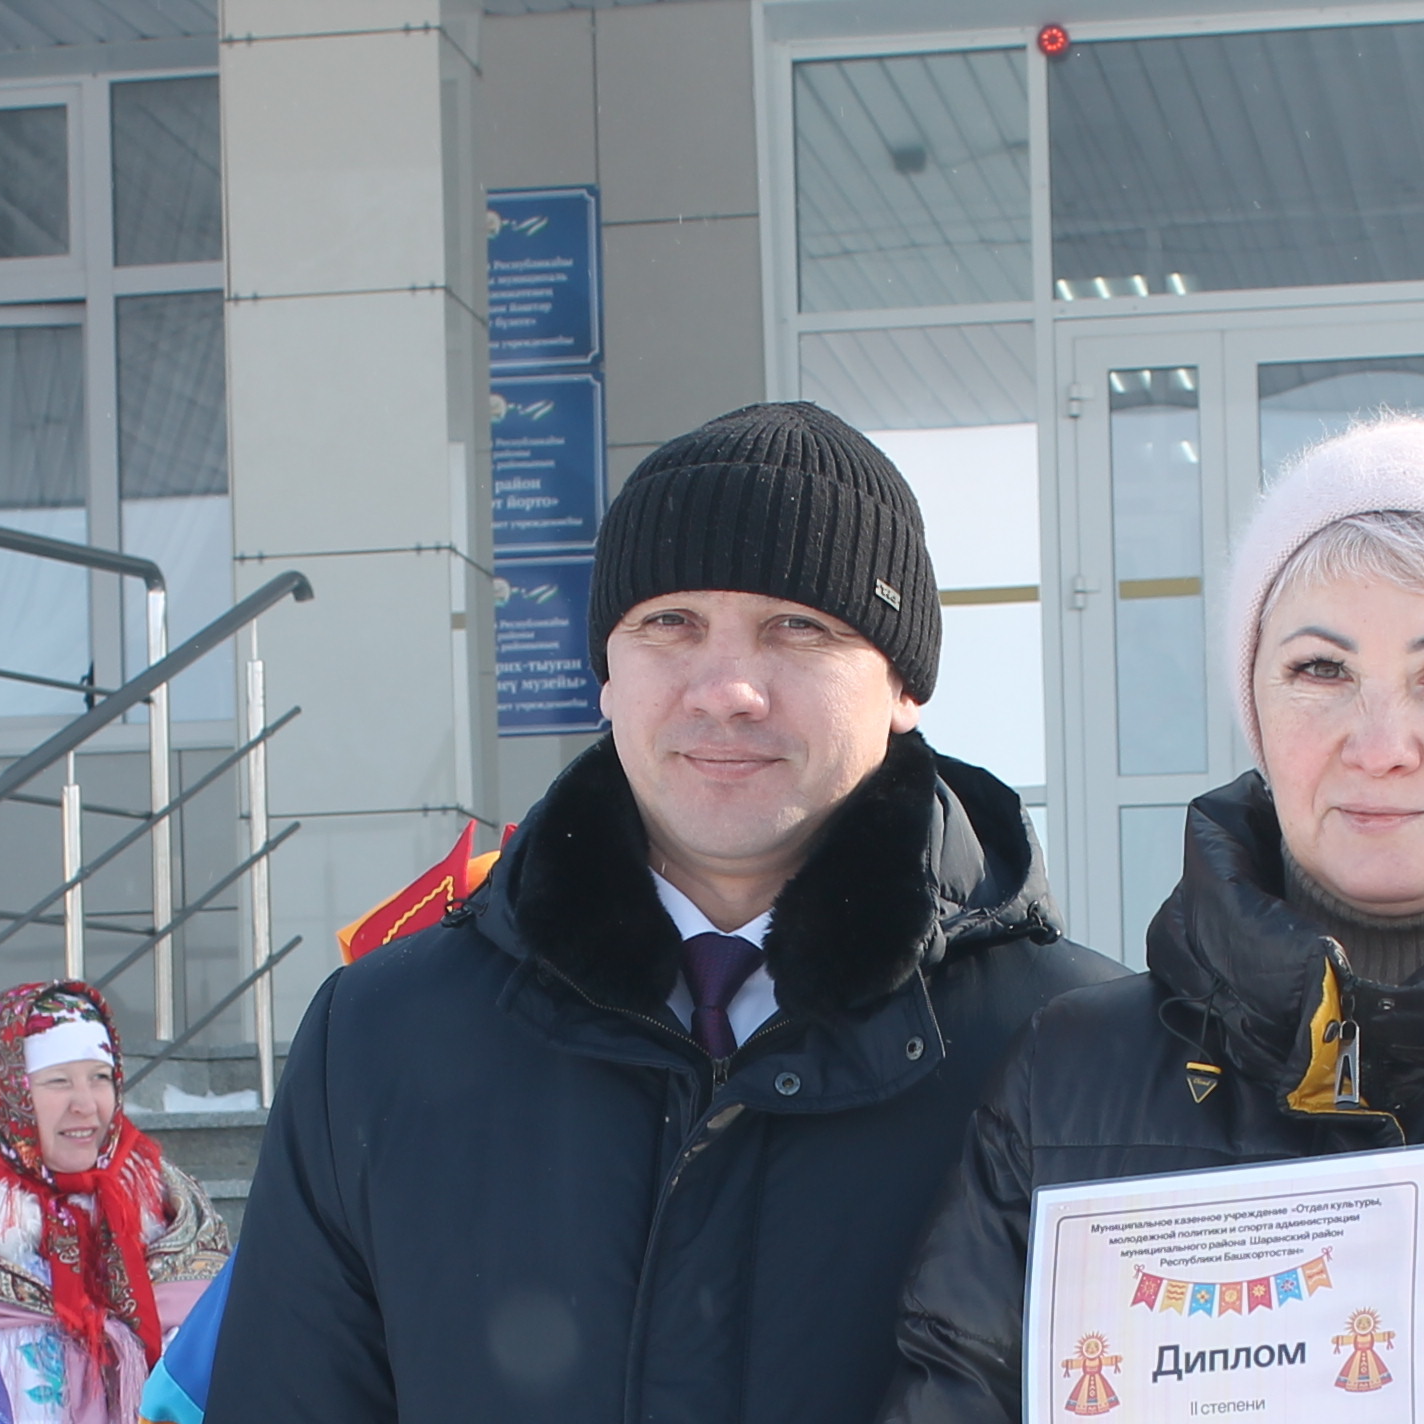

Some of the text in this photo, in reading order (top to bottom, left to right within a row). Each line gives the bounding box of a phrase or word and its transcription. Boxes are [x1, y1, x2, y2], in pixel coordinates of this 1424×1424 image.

[495, 476, 541, 494] район
[1091, 1198, 1382, 1233] Муниципальное казенное учреждение «Отдел культуры,
[1109, 1214, 1361, 1245] молодежной политики и спорта администрации
[1120, 1229, 1344, 1258] муниципального района Шаранский район
[1160, 1253, 1222, 1268] Республики
[1152, 1342, 1306, 1383] Диплом
[1200, 1399, 1266, 1416] степени
